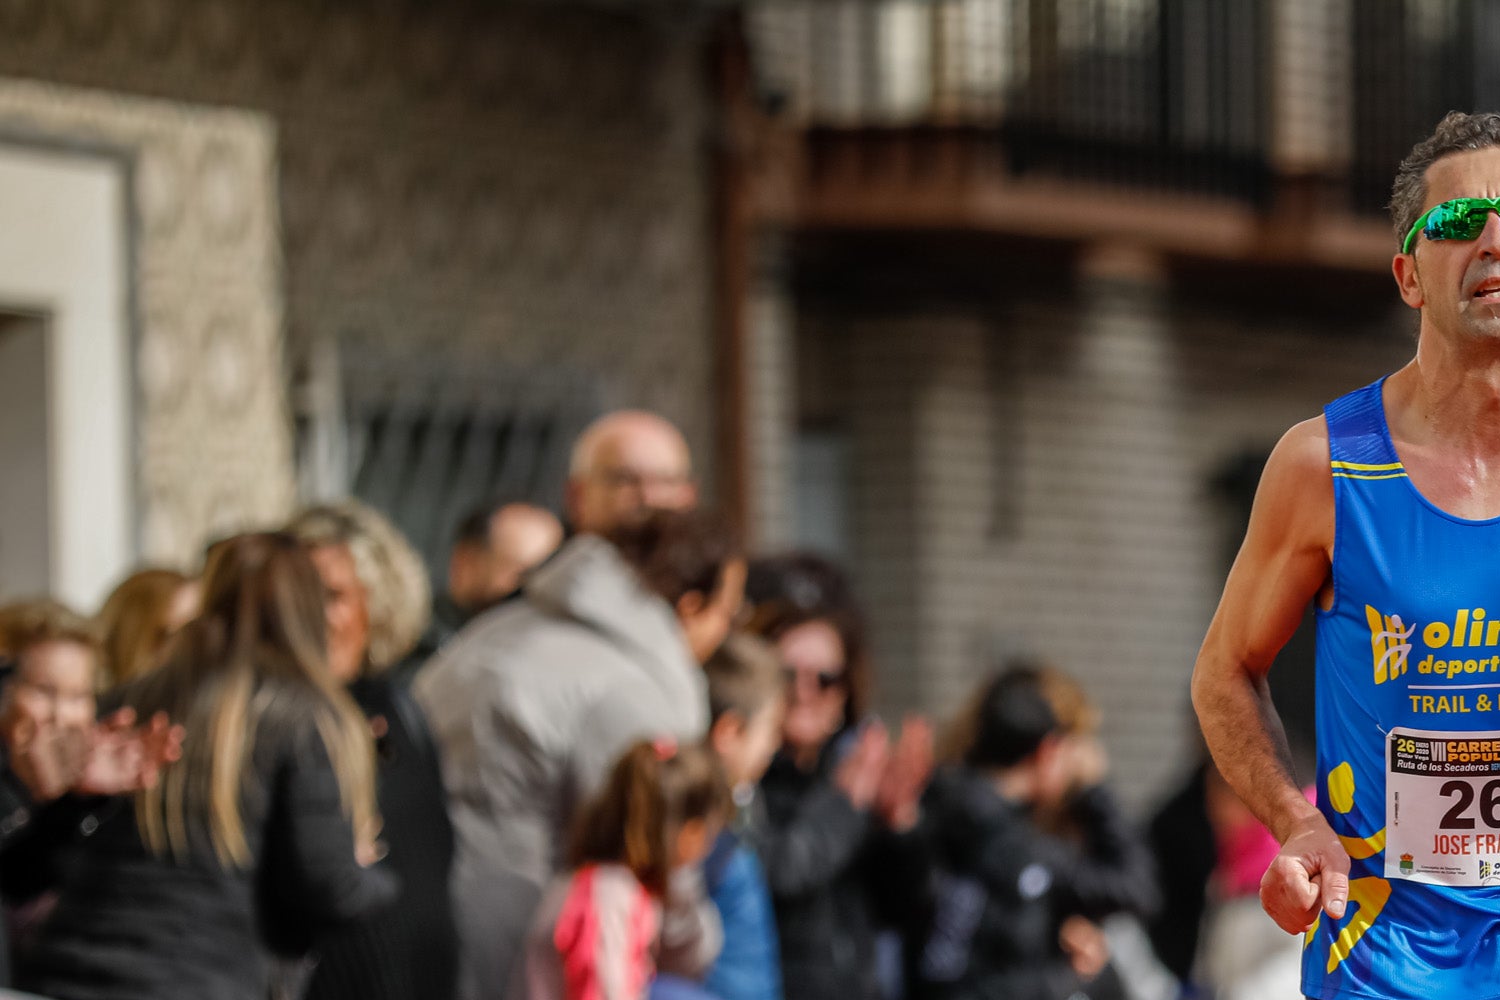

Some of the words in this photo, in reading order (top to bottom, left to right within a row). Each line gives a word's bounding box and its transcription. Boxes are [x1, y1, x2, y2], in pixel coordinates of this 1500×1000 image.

[1409, 695, 1471, 713] TRAIL
[1476, 694, 1492, 712] &
[1397, 739, 1415, 753] 26
[1430, 742, 1446, 761] VII
[1397, 759, 1416, 769] Ruta
[1417, 762, 1428, 771] de
[1429, 763, 1442, 771] los
[1443, 763, 1490, 772] Secaderos
[1432, 834, 1471, 855] JOSE
